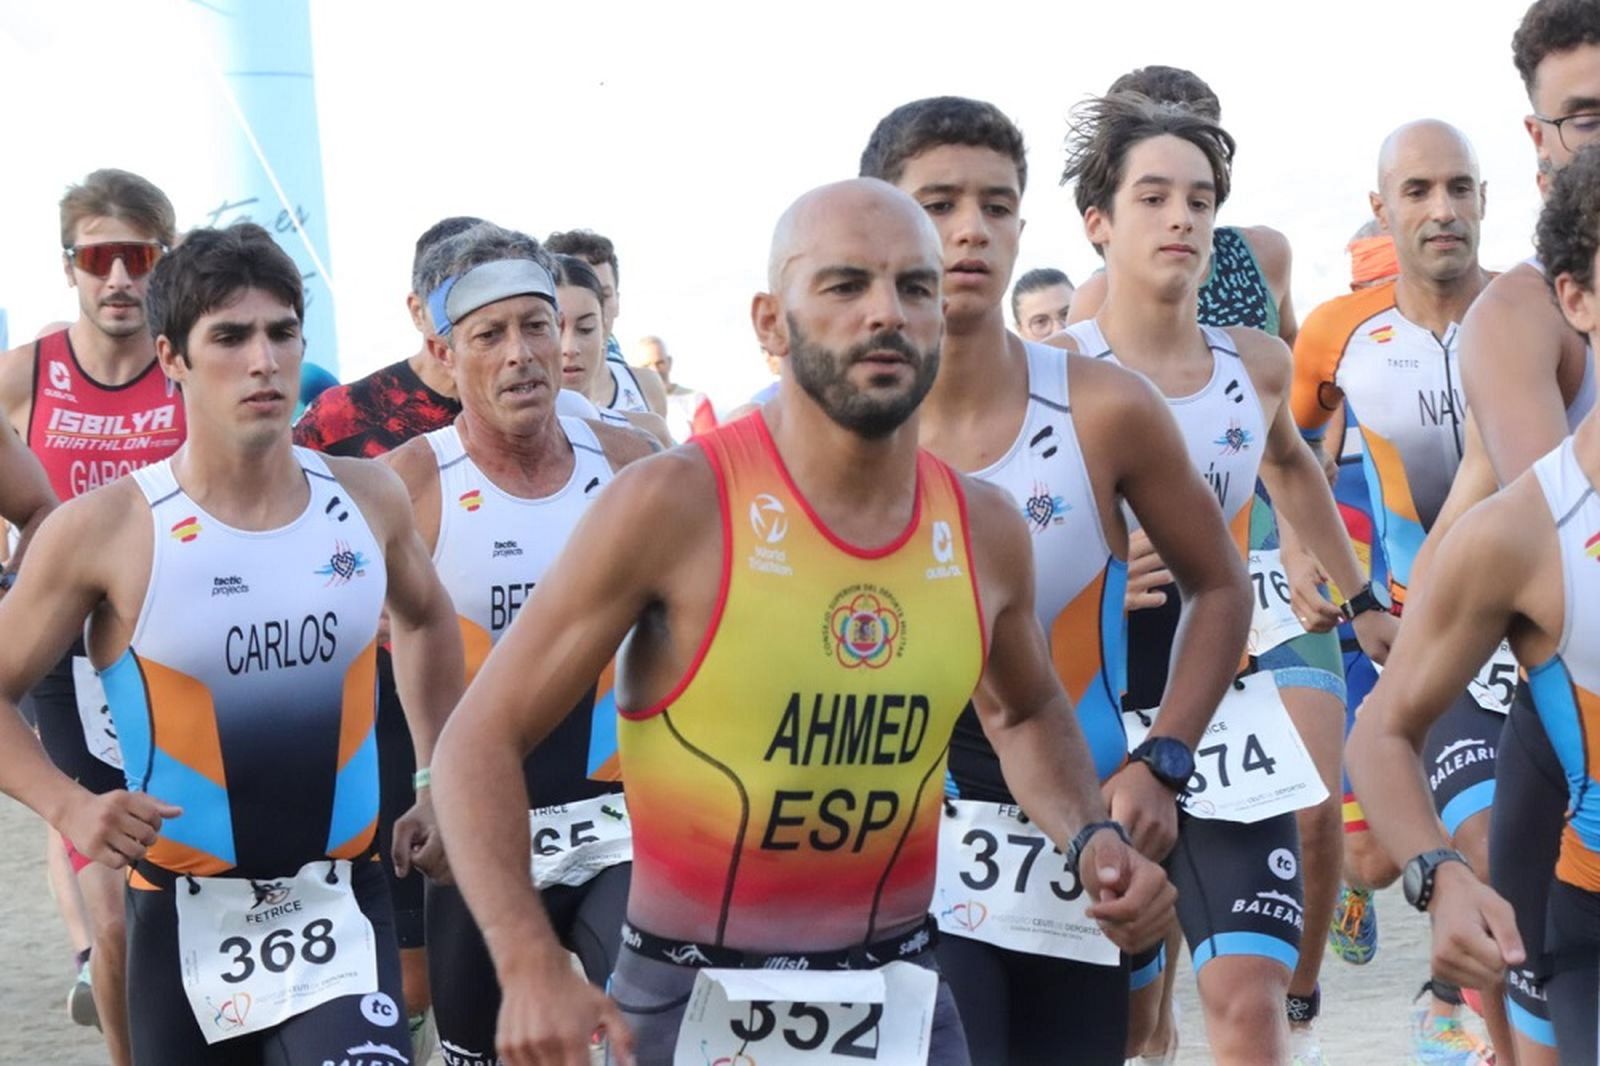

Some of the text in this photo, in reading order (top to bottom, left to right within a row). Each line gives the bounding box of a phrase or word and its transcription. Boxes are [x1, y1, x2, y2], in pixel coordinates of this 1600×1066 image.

[48, 404, 176, 435] ISBILYA
[44, 434, 152, 451] TRIATHLON
[211, 584, 249, 597] projects
[213, 575, 243, 586] tactic
[1252, 570, 1291, 610] 76
[225, 611, 339, 676] CARLOS
[763, 692, 930, 767] AHMED
[1430, 747, 1495, 792] BALEARI
[533, 805, 568, 817] TRICE
[760, 788, 900, 854] ESP
[998, 804, 1021, 819] FE
[533, 820, 600, 857] 65
[1276, 855, 1292, 871] tc
[246, 900, 304, 924] FETRICE
[1231, 898, 1304, 932] BALEAR
[219, 918, 336, 984] 368
[371, 999, 393, 1017] tc
[730, 1000, 884, 1060] 352
